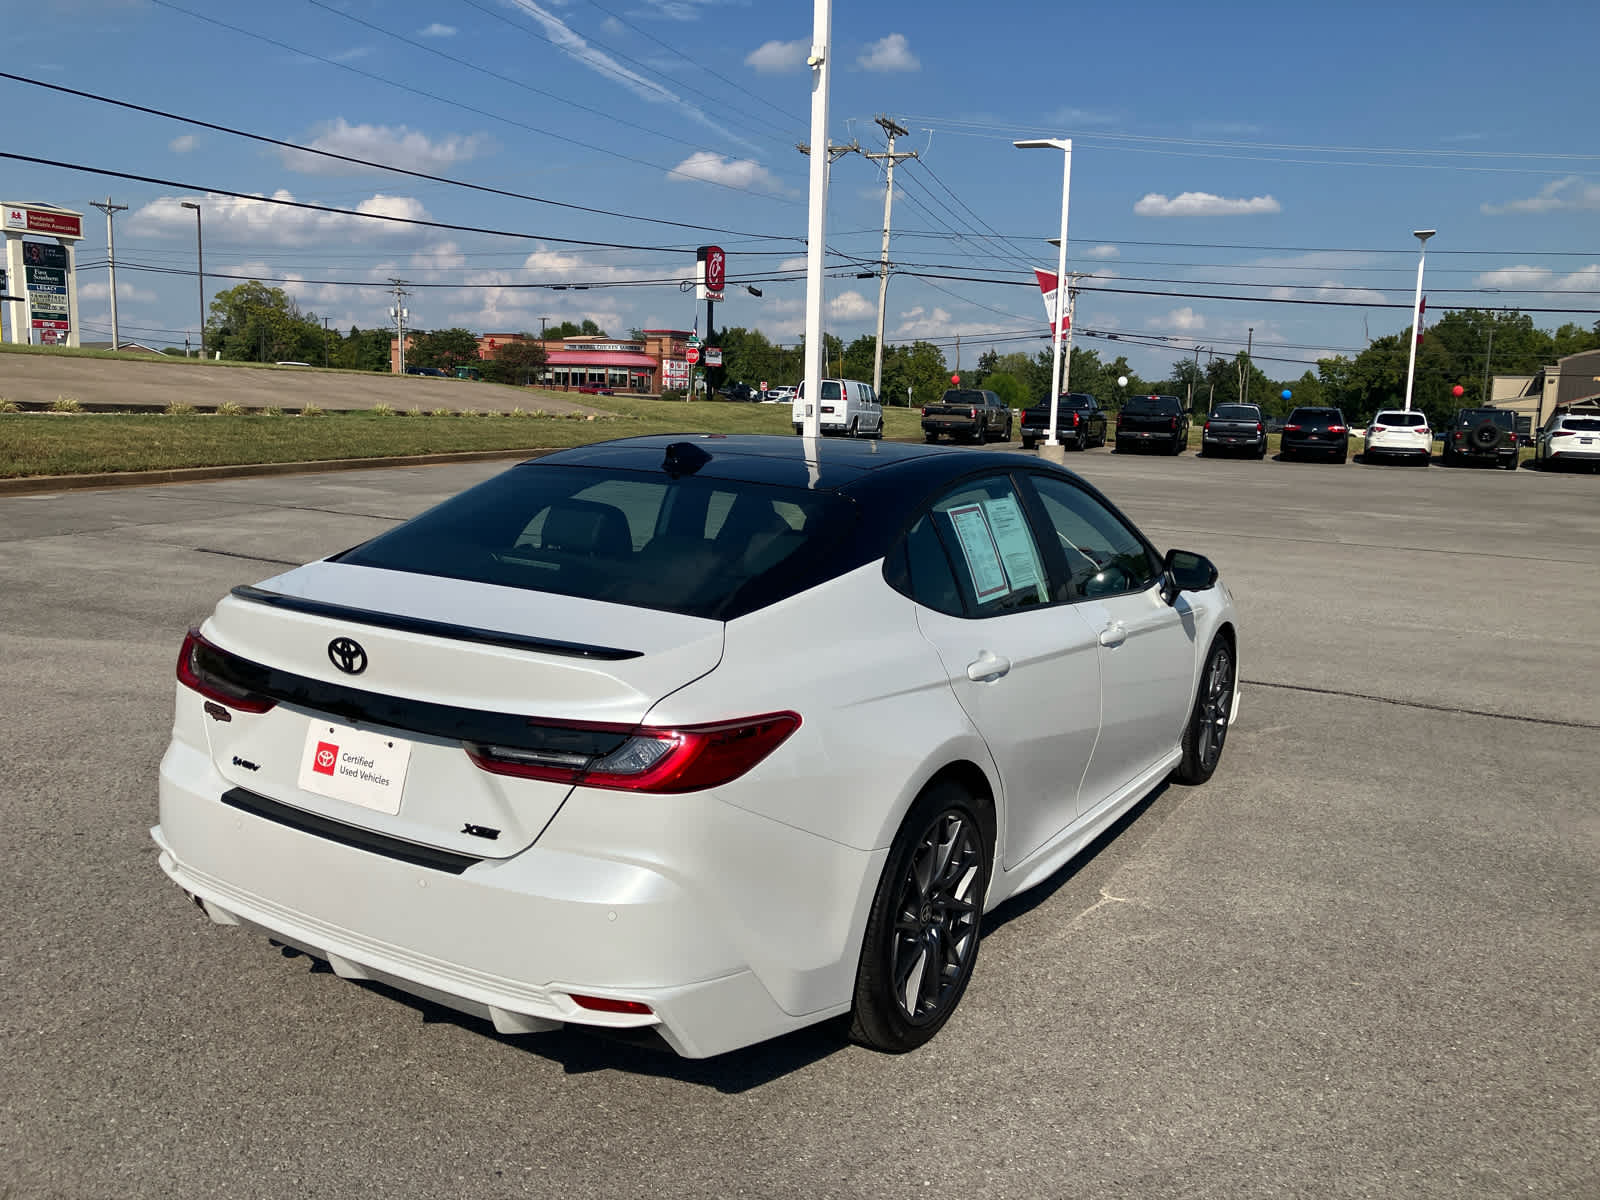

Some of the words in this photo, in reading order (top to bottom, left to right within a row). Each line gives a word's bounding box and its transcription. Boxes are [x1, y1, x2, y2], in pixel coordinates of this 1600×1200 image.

[687, 352, 698, 360] STOP
[342, 752, 375, 768] Certified
[340, 765, 358, 778] Used
[359, 770, 390, 786] Vehicles
